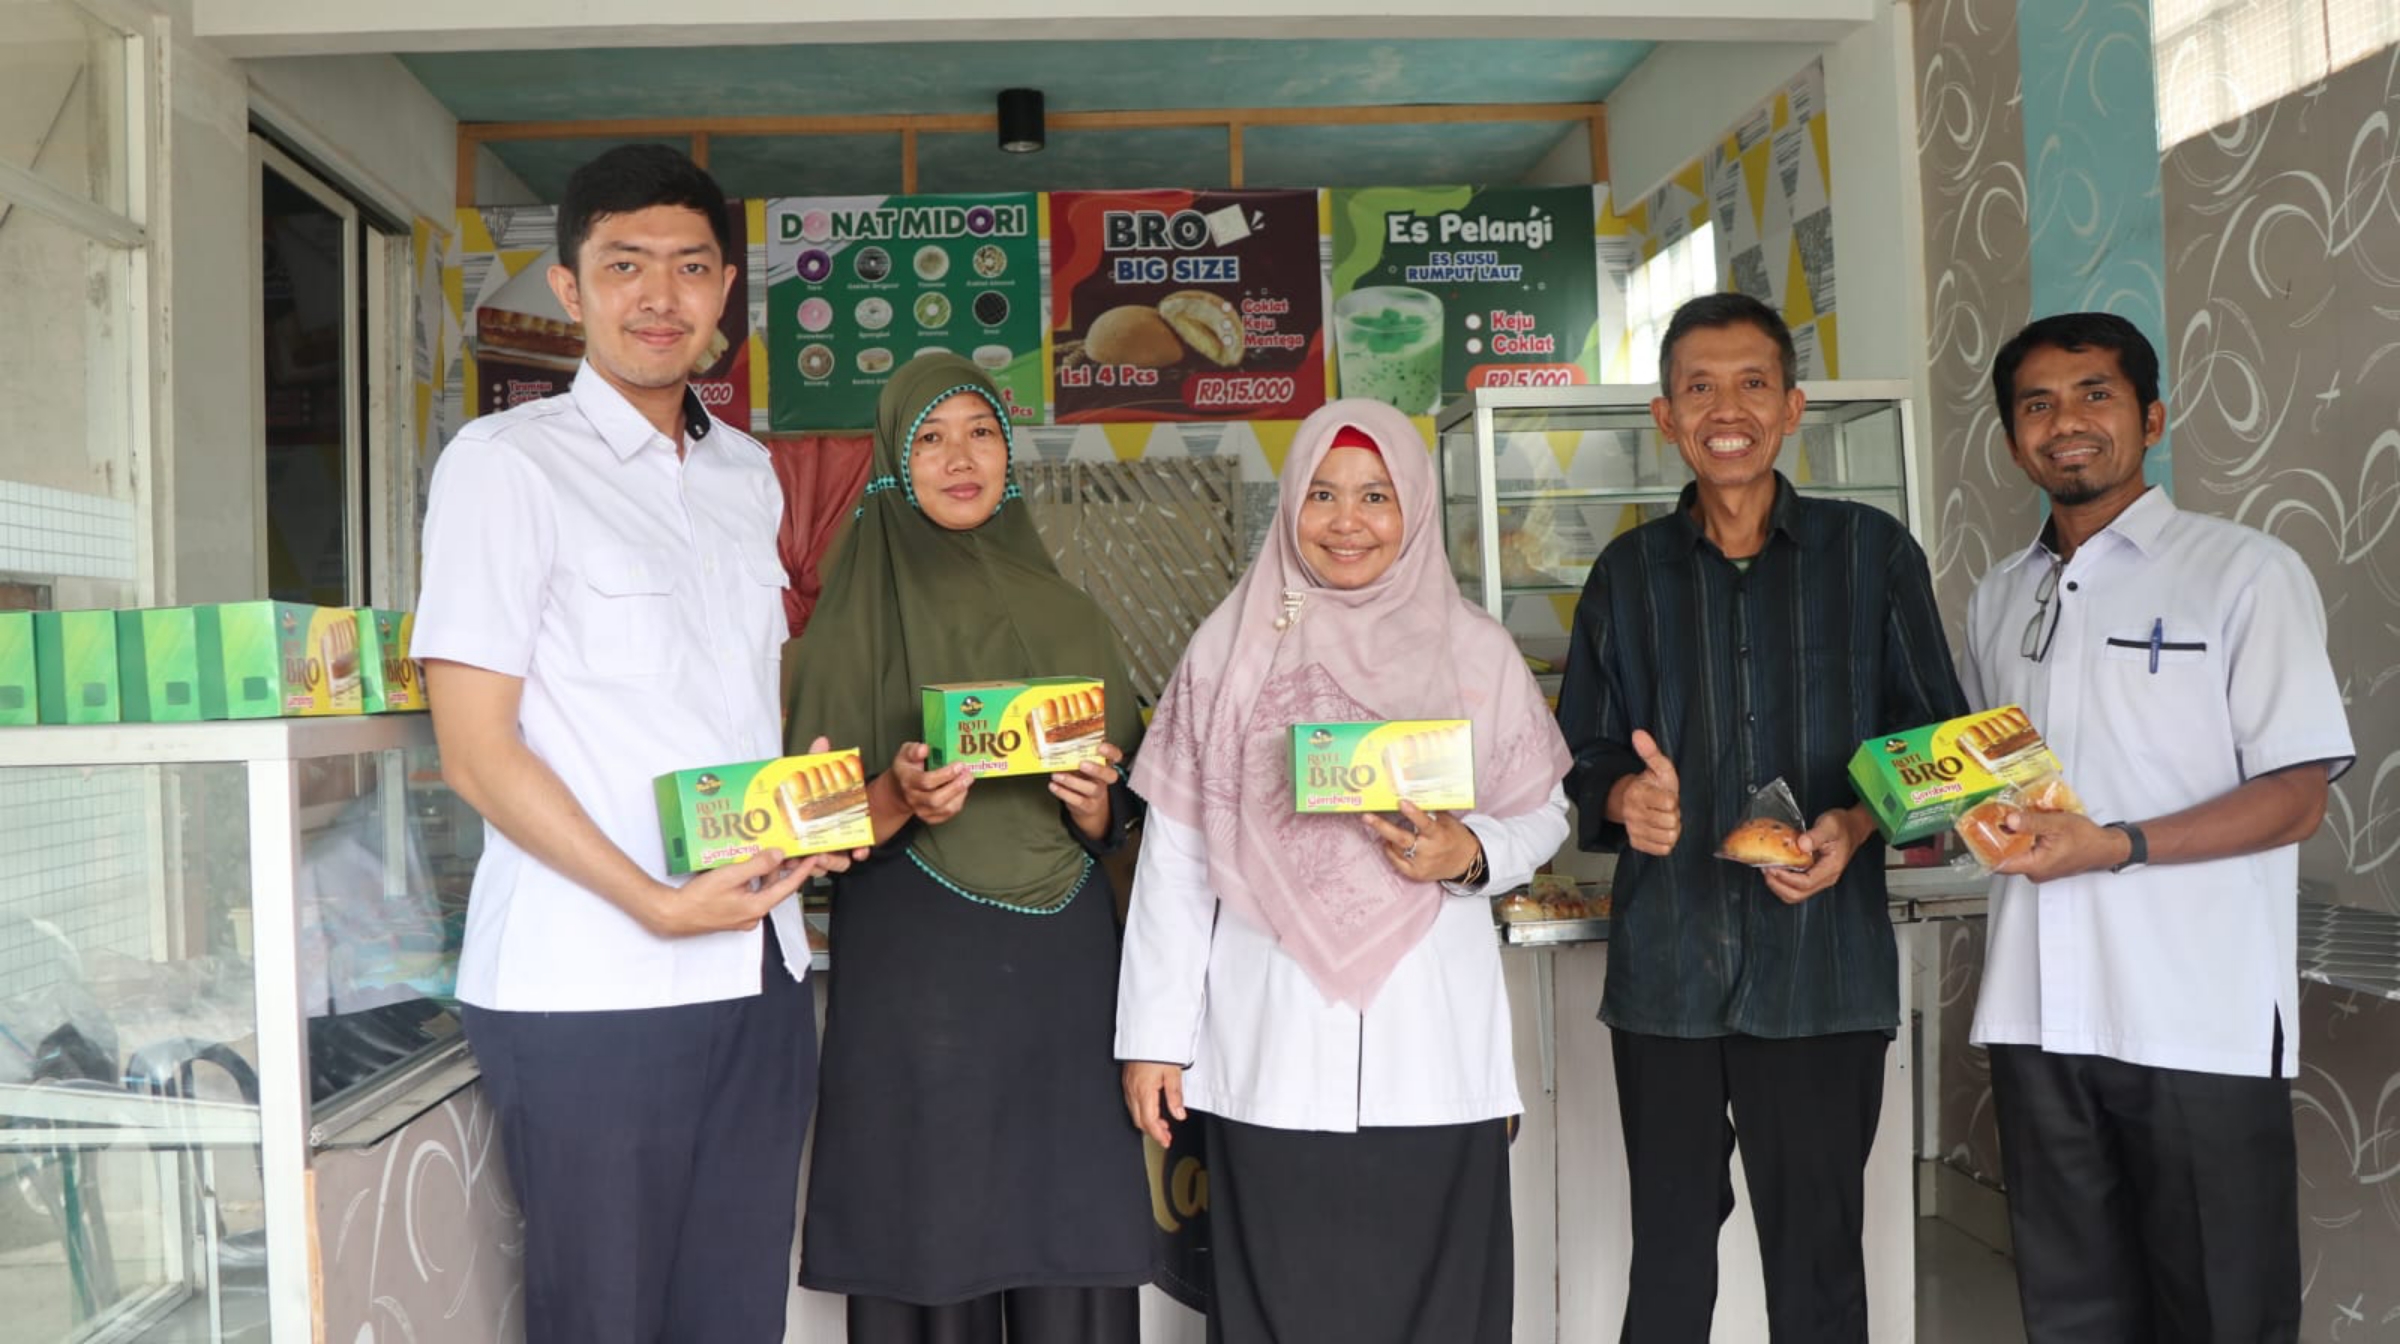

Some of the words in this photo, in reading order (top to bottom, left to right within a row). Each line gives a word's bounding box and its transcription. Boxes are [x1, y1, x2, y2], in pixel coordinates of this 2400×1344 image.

[779, 207, 897, 241] DONAT
[899, 205, 1027, 239] MIDORI
[1104, 209, 1210, 250] BRO
[1387, 213, 1429, 243] Es
[1115, 257, 1166, 284] BIG
[1173, 256, 1239, 282] SIZE
[1430, 251, 1451, 266] ES
[1455, 251, 1498, 266] SUSU
[1406, 265, 1476, 282] RUMPUT
[1479, 264, 1523, 281] LAUT
[1241, 298, 1289, 314] Coklat
[1243, 315, 1276, 332] Keju
[1490, 311, 1534, 331] Keju
[1243, 331, 1304, 350] Mentega
[1492, 334, 1554, 353] Coklat
[1061, 367, 1090, 387] Isi
[1096, 367, 1114, 385] 4
[1121, 366, 1158, 385] Pcs
[1486, 369, 1572, 387] RP5000
[1195, 377, 1294, 406] RP.15.000
[959, 729, 1021, 758] BRO
[1309, 765, 1376, 792] BRO
[1901, 756, 1964, 786] BRO
[699, 808, 771, 840] BRO
